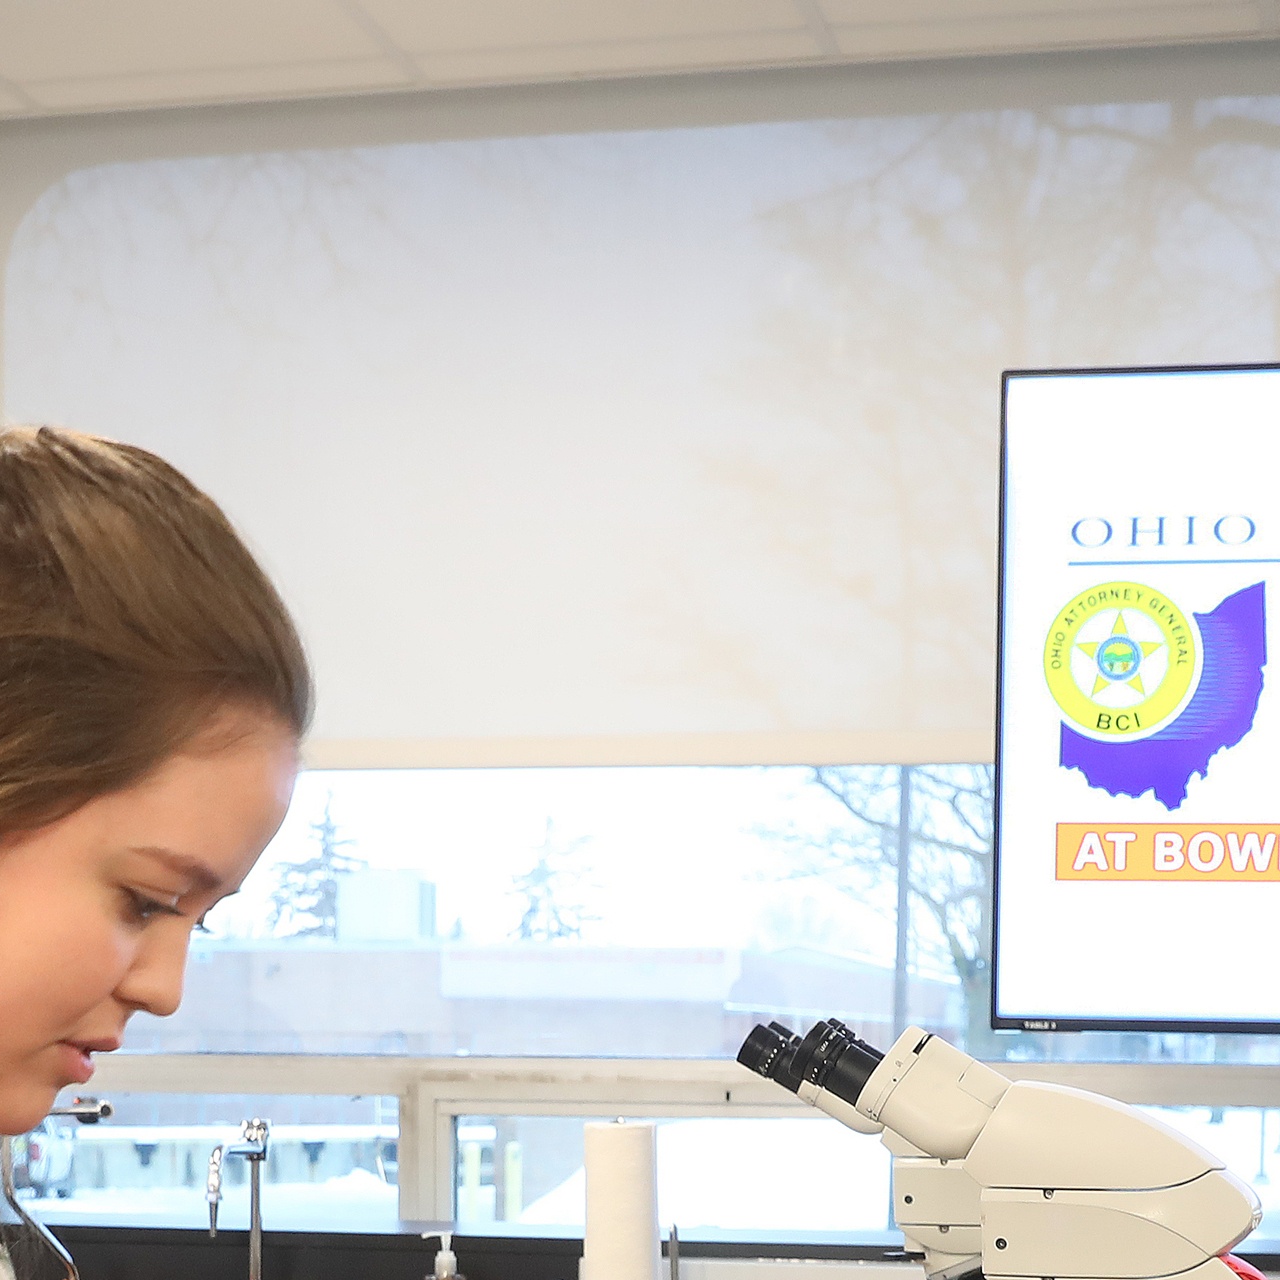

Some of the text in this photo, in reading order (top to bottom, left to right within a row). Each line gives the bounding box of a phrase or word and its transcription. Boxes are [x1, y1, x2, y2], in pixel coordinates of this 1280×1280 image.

[1071, 515, 1257, 546] OHIO
[1051, 588, 1188, 669] OHIO ATTORNEY GENERAL
[1095, 712, 1141, 732] BCI
[1073, 832, 1137, 871] AT
